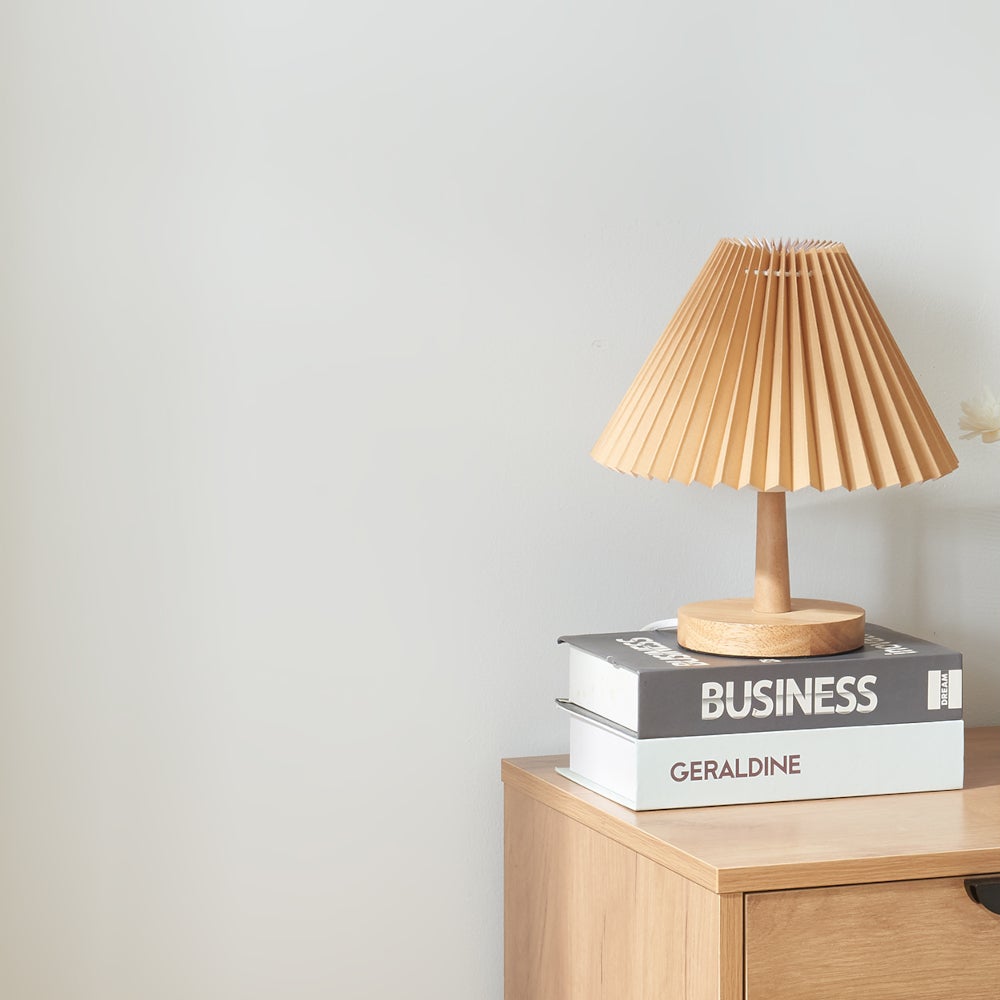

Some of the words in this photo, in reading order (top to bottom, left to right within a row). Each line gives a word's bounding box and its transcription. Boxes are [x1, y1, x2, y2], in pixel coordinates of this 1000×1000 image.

[615, 637, 711, 667] BUSINESS
[701, 675, 878, 720] BUSINESS
[941, 673, 949, 706] DREAM
[670, 754, 801, 783] GERALDINE
